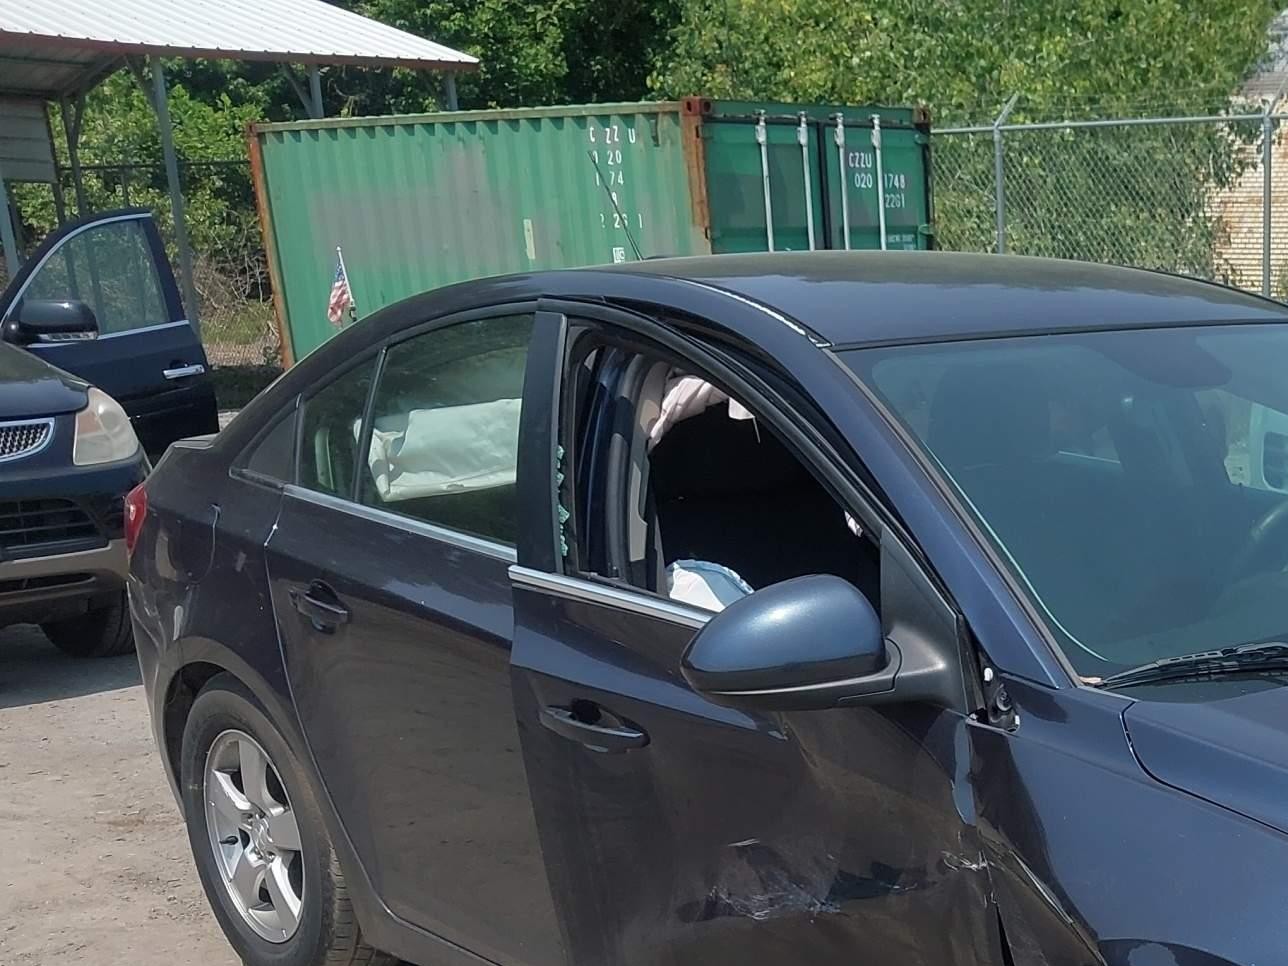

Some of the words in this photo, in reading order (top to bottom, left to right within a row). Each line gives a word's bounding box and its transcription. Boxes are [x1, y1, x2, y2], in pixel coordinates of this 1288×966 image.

[848, 152, 872, 168] CZZU
[854, 172, 873, 189] 020
[884, 173, 906, 189] 1748
